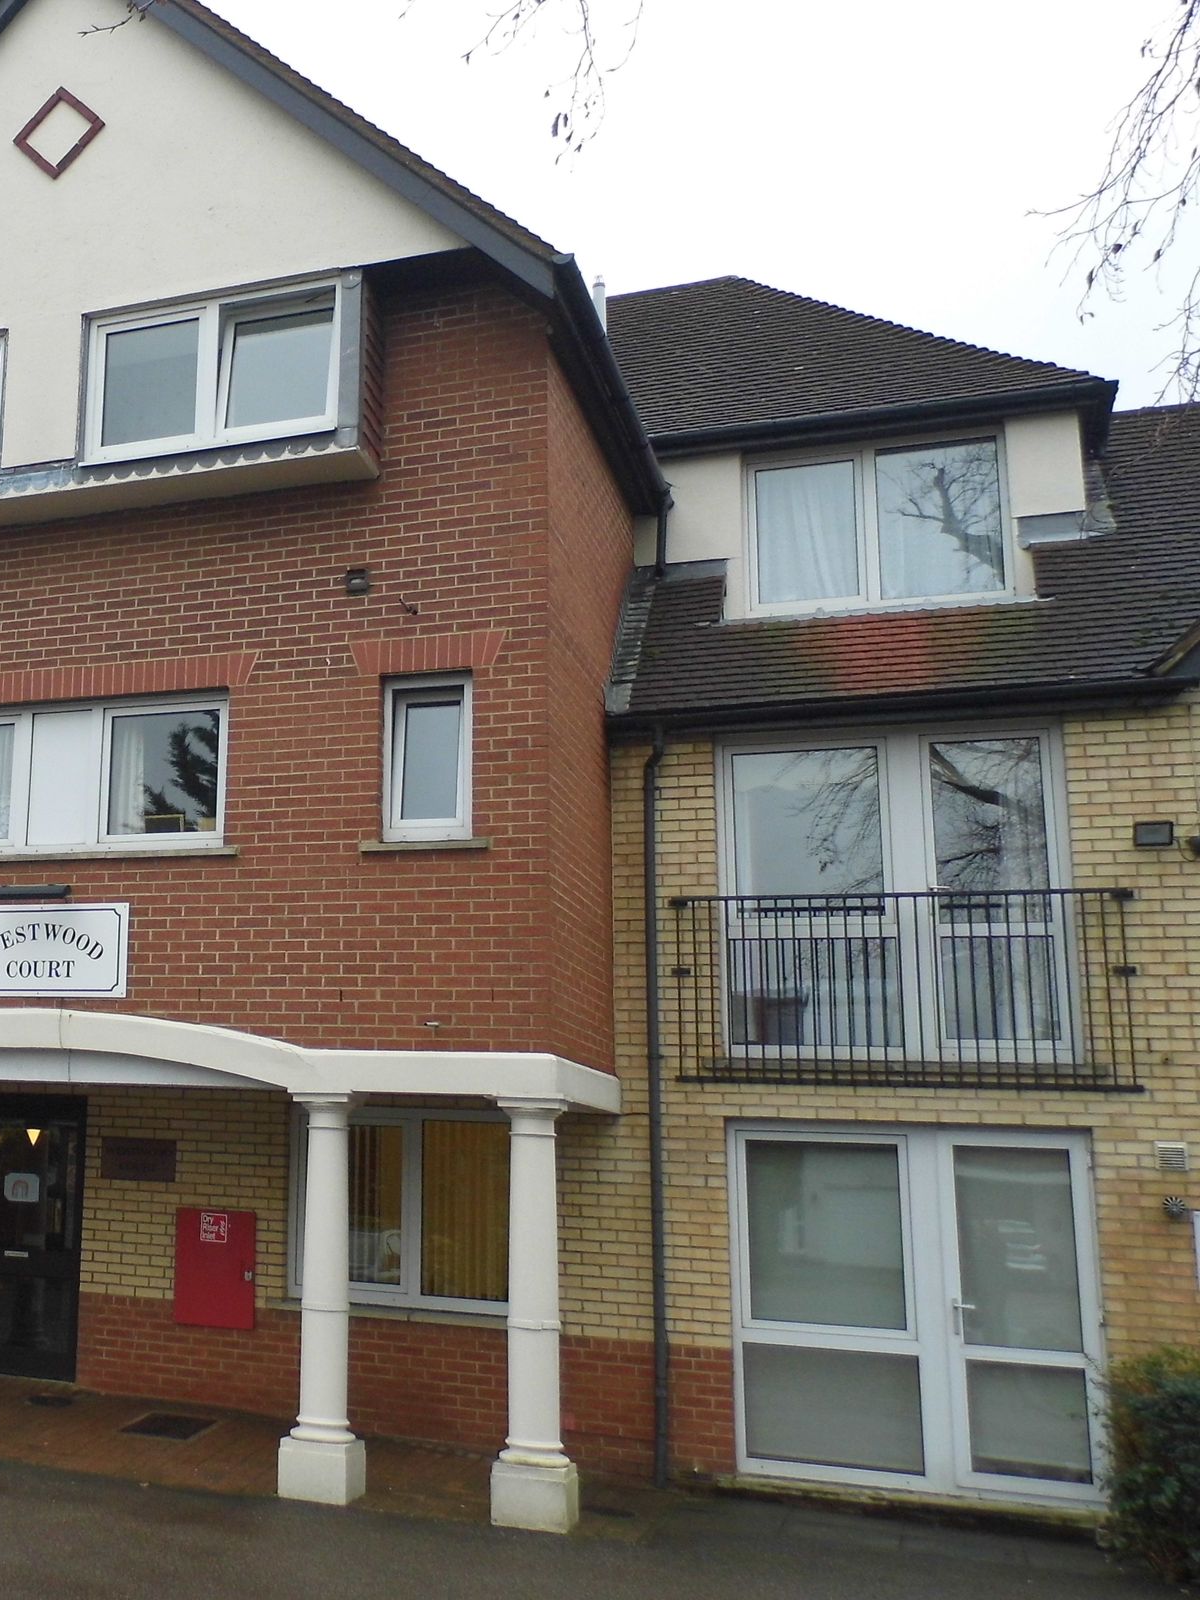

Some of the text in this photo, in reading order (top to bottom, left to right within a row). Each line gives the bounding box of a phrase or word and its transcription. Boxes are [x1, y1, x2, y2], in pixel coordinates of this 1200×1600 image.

[6, 960, 75, 979] COURT
[202, 1214, 215, 1225] Dry
[202, 1223, 219, 1232] Riser
